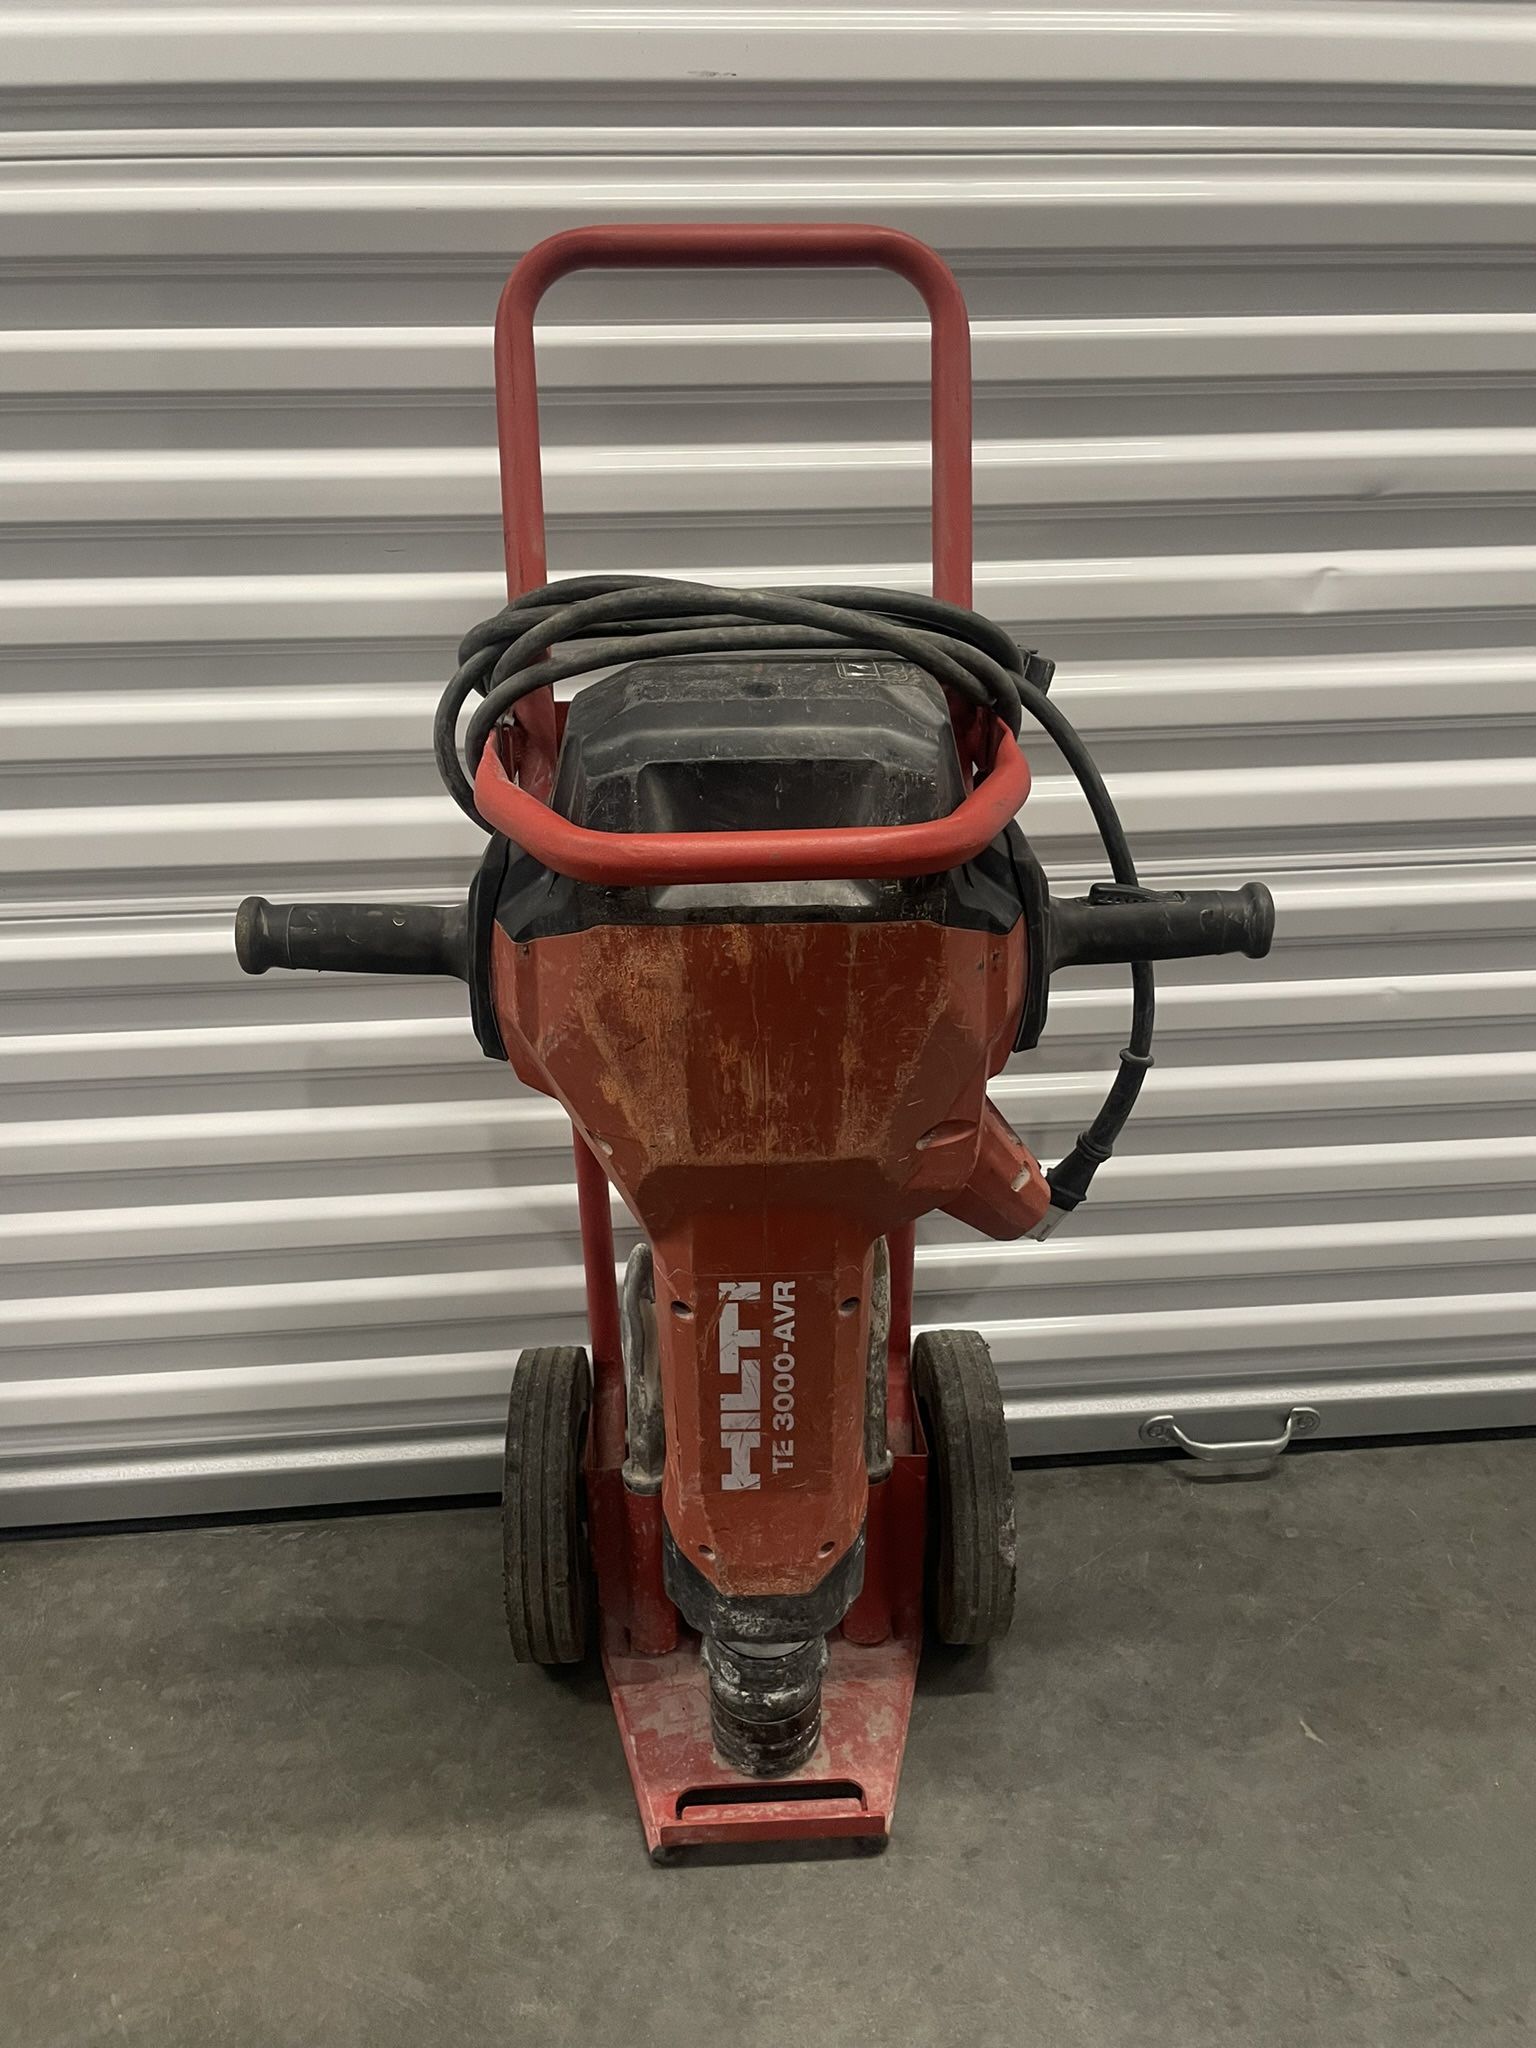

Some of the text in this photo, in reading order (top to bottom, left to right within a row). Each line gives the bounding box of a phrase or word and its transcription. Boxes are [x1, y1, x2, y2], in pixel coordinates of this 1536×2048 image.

[718, 1282, 761, 1490] HILTI
[772, 1280, 796, 1474] TE 3000-AVR
